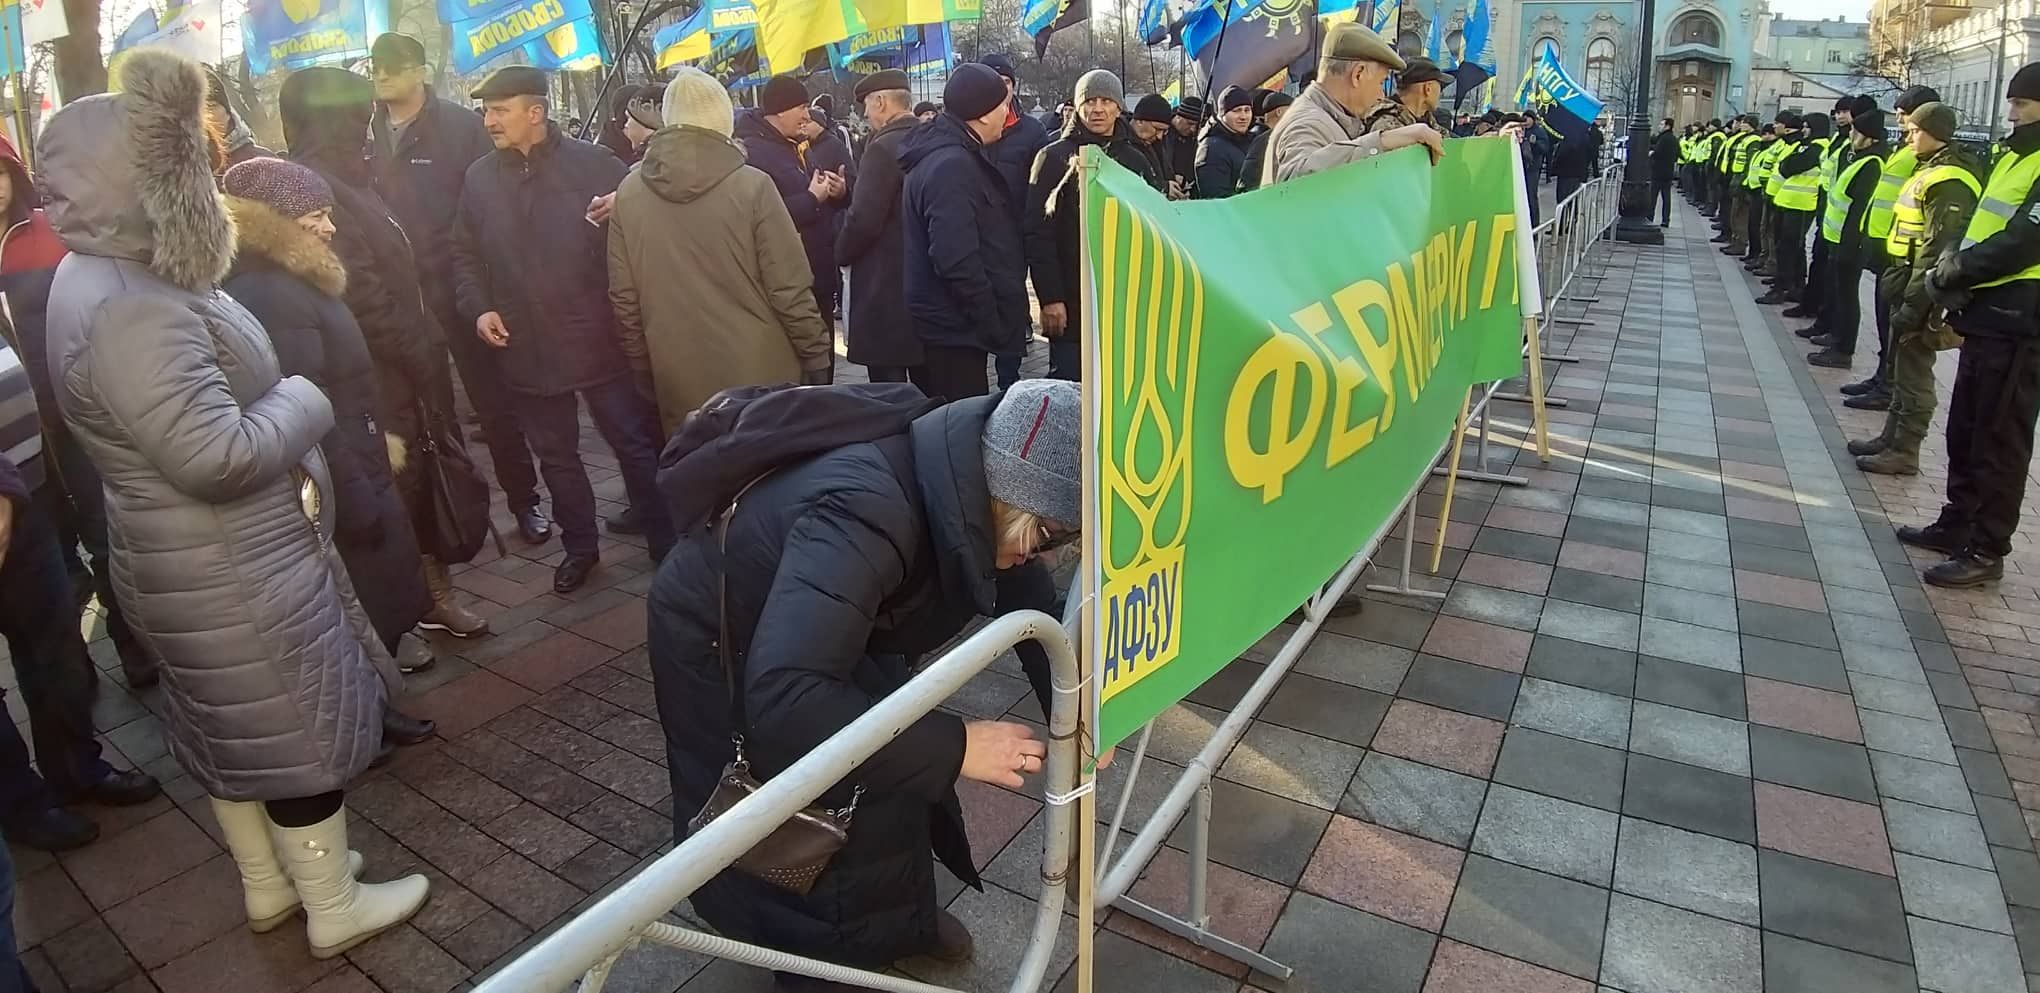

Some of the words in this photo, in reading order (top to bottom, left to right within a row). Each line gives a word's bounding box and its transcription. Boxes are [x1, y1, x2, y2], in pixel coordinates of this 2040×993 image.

[1540, 62, 1580, 101] НПГУ
[1224, 220, 1477, 505] ФЕРМЕРИ
[1102, 560, 1179, 690] АФЗУ
